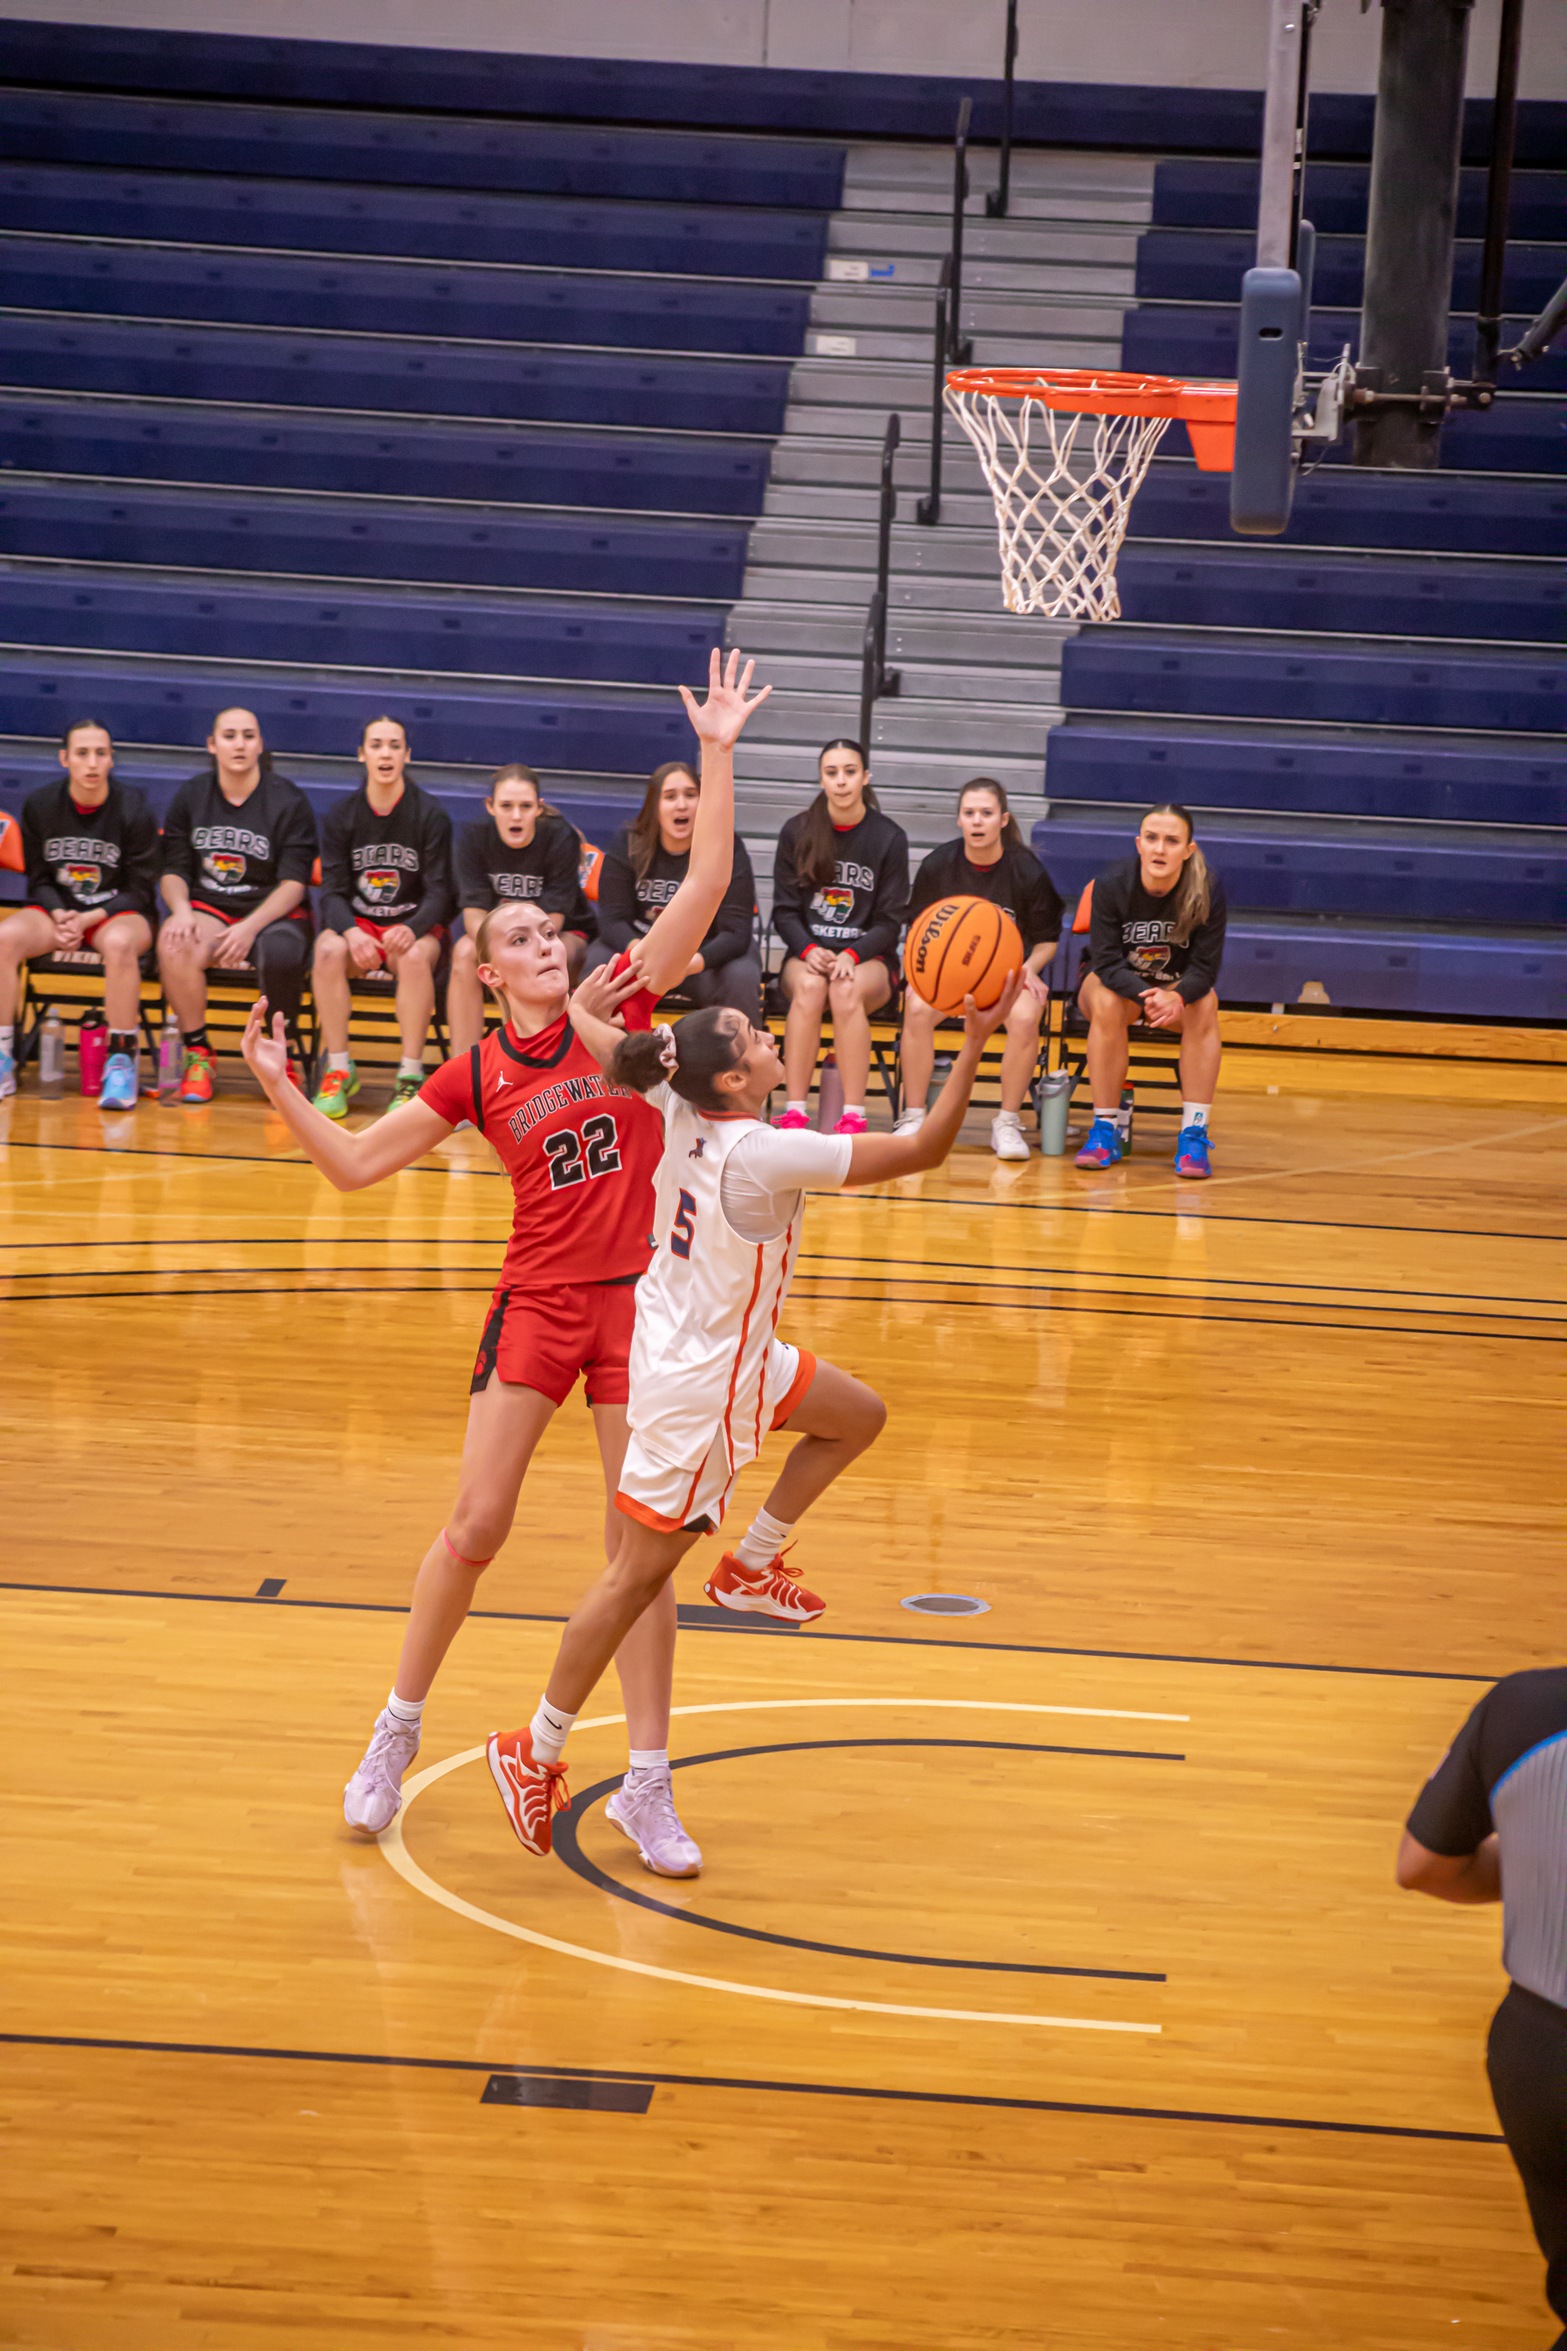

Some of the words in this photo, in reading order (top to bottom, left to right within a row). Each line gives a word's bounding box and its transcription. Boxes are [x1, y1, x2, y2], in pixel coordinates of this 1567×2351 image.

[43, 836, 121, 868] BEARS
[191, 825, 270, 860] BEARS
[488, 873, 544, 898] EAR
[635, 879, 683, 903] BEA
[833, 861, 875, 892] ARS
[915, 904, 960, 975] Wilson
[1122, 920, 1190, 949] BEAR
[542, 1112, 622, 1191] 22
[670, 1187, 697, 1261] 5
